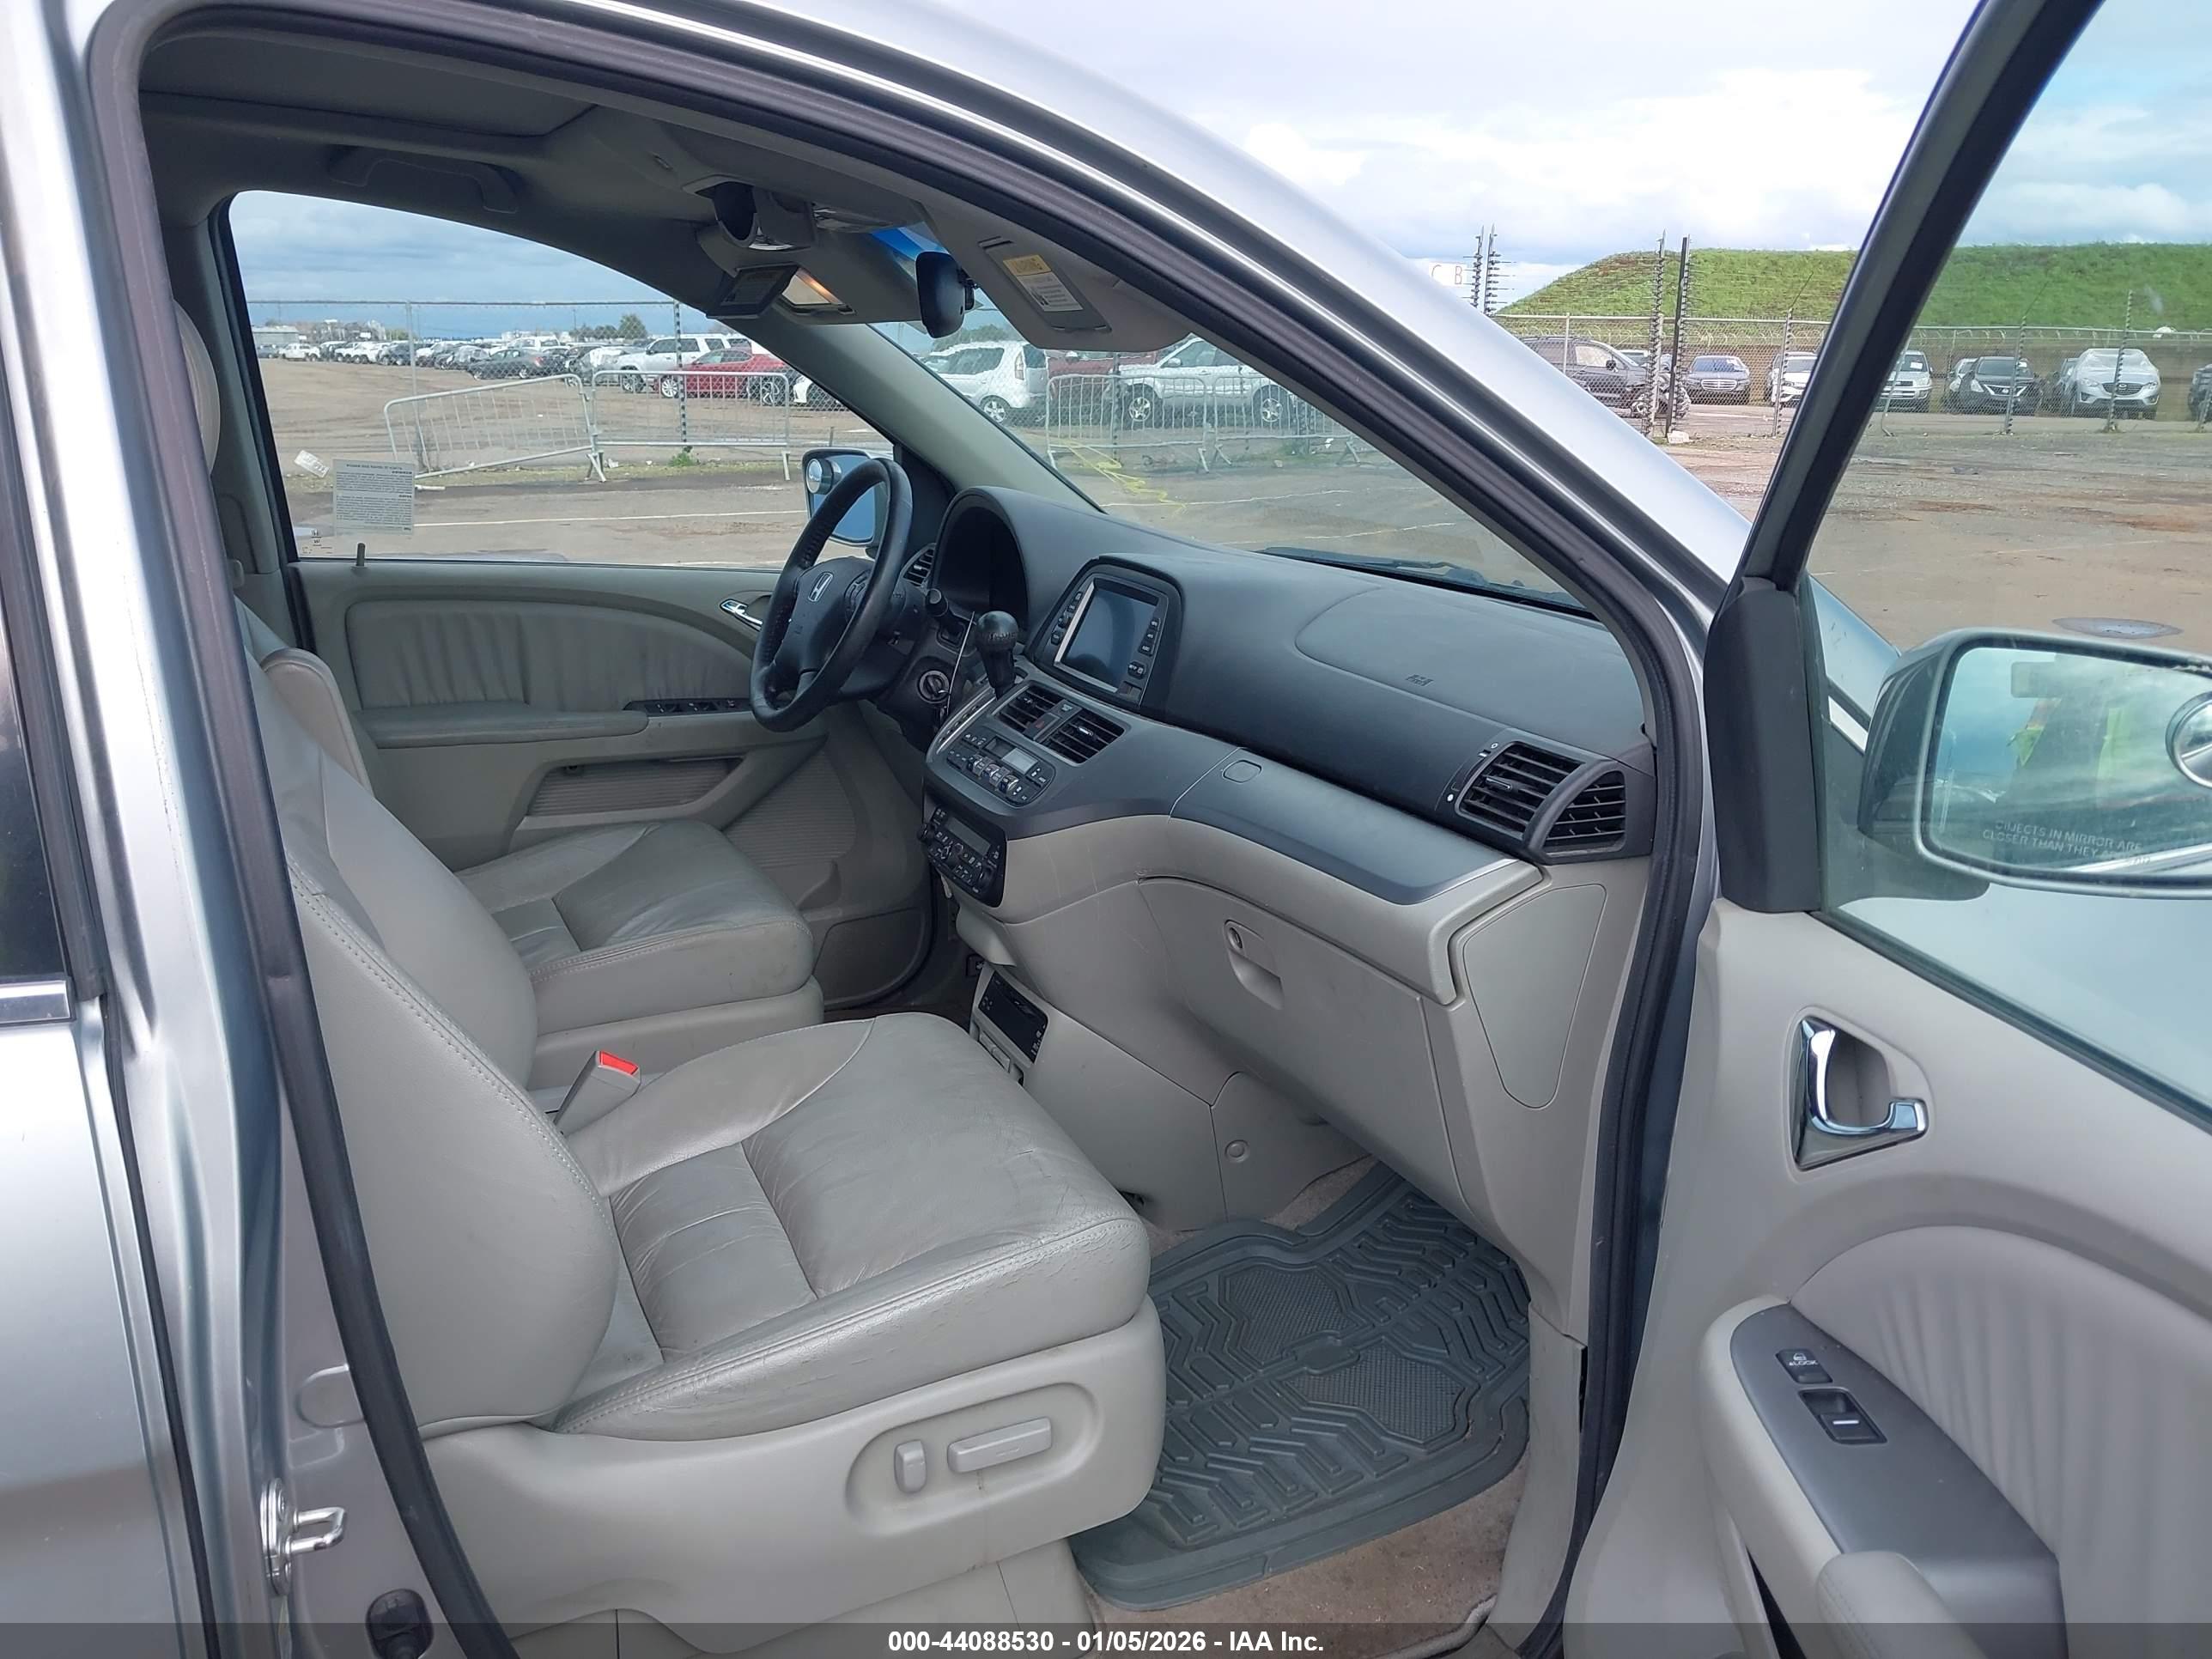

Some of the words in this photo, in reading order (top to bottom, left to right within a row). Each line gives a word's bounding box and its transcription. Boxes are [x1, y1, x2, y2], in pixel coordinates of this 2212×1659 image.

[1983, 829, 2028, 846] CLOSER
[2032, 837, 2064, 852] THAN
[2067, 843, 2099, 859] THEY
[2049, 828, 2063, 840] IN
[2064, 830, 2114, 849] MIRROR
[2117, 840, 2142, 853] ARE
